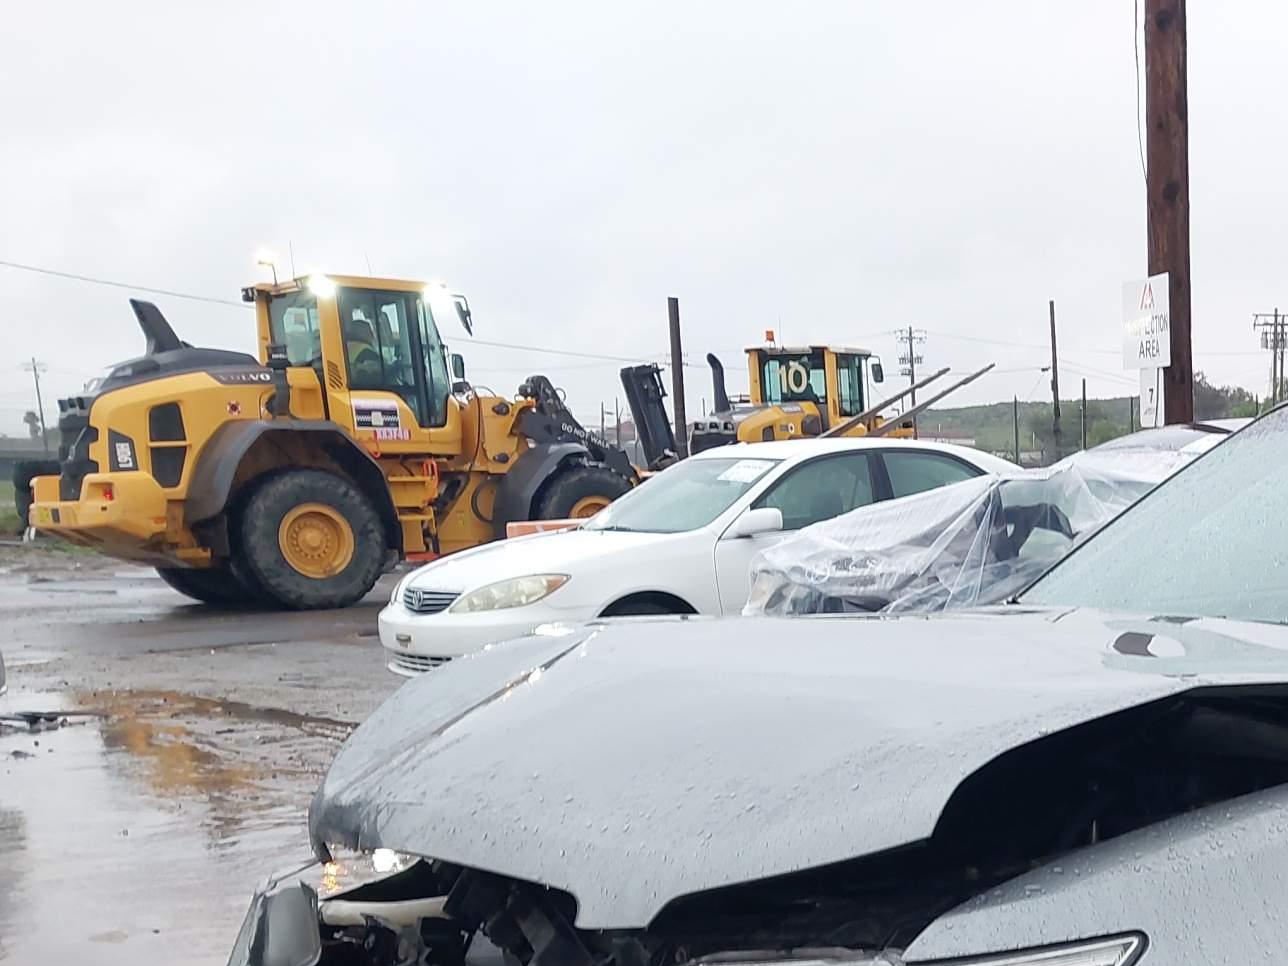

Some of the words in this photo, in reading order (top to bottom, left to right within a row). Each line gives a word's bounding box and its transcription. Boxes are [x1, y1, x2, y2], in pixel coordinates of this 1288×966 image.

[1139, 337, 1161, 360] AREA
[778, 359, 807, 393] 10
[1149, 387, 1155, 405] 7
[561, 422, 573, 434] DO
[573, 427, 588, 440] NOT
